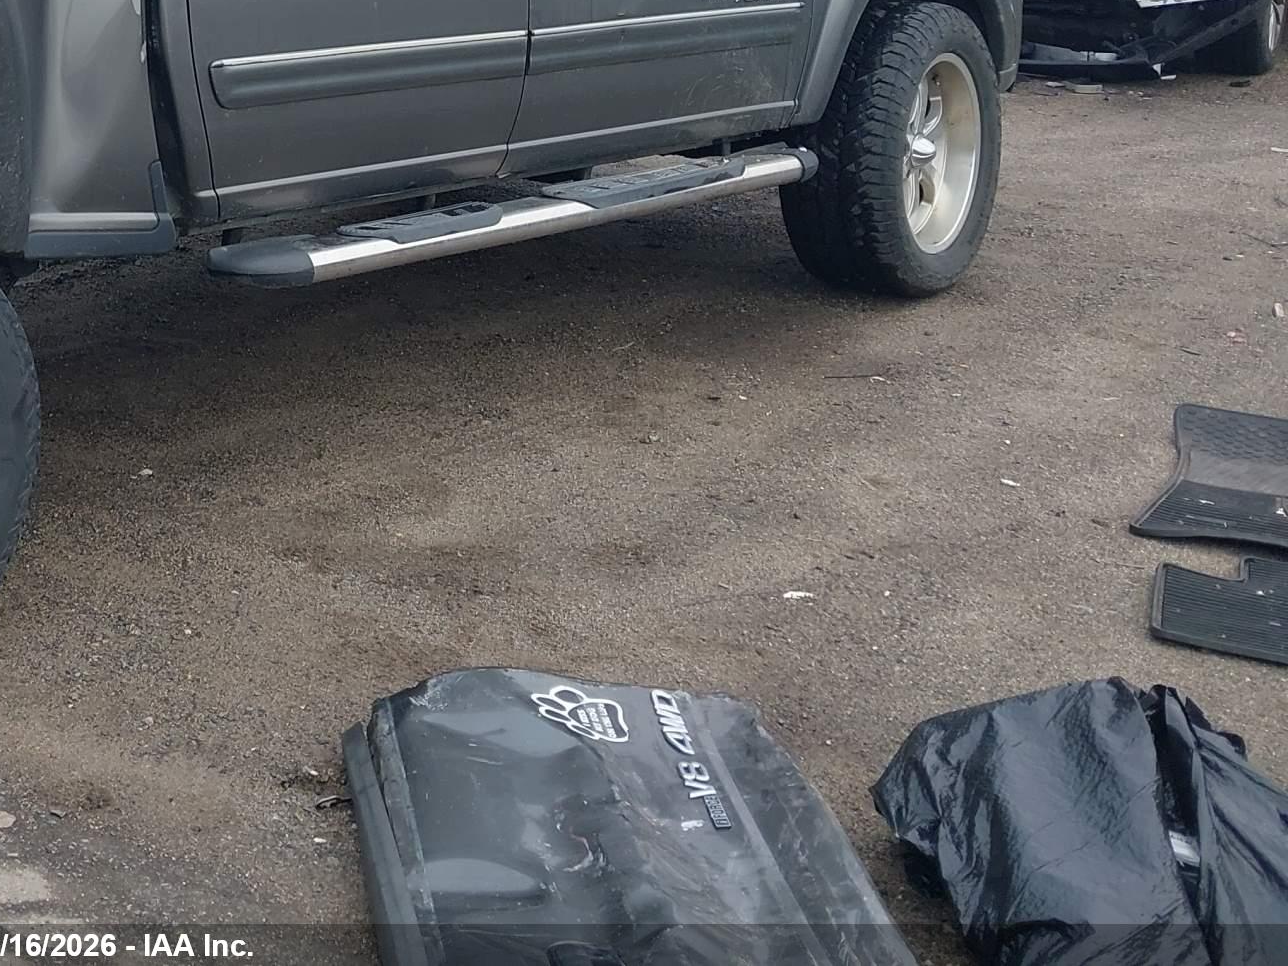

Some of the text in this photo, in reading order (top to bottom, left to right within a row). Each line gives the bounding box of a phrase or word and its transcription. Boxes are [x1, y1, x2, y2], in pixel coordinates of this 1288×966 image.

[585, 707, 600, 722] DOG
[601, 716, 613, 728] THE
[651, 689, 695, 755] 4WD
[606, 728, 617, 739] ON
[678, 761, 716, 798] V8
